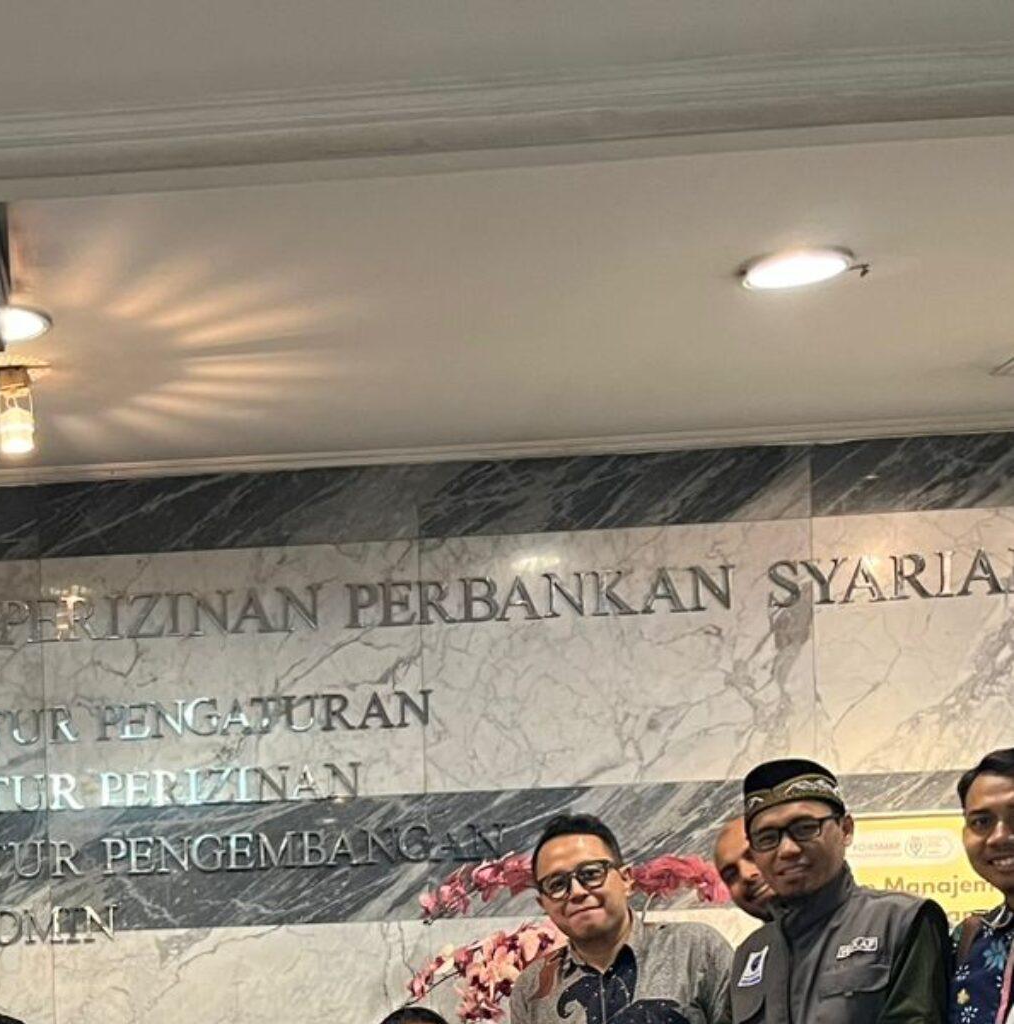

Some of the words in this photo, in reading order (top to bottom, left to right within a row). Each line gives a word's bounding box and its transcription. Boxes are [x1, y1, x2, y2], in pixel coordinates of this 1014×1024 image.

[345, 564, 736, 629] PERBANKAN
[95, 690, 433, 742] PENGATURAN
[99, 761, 362, 809] PERIZINAN
[101, 822, 504, 878] PENGEMBANGAN
